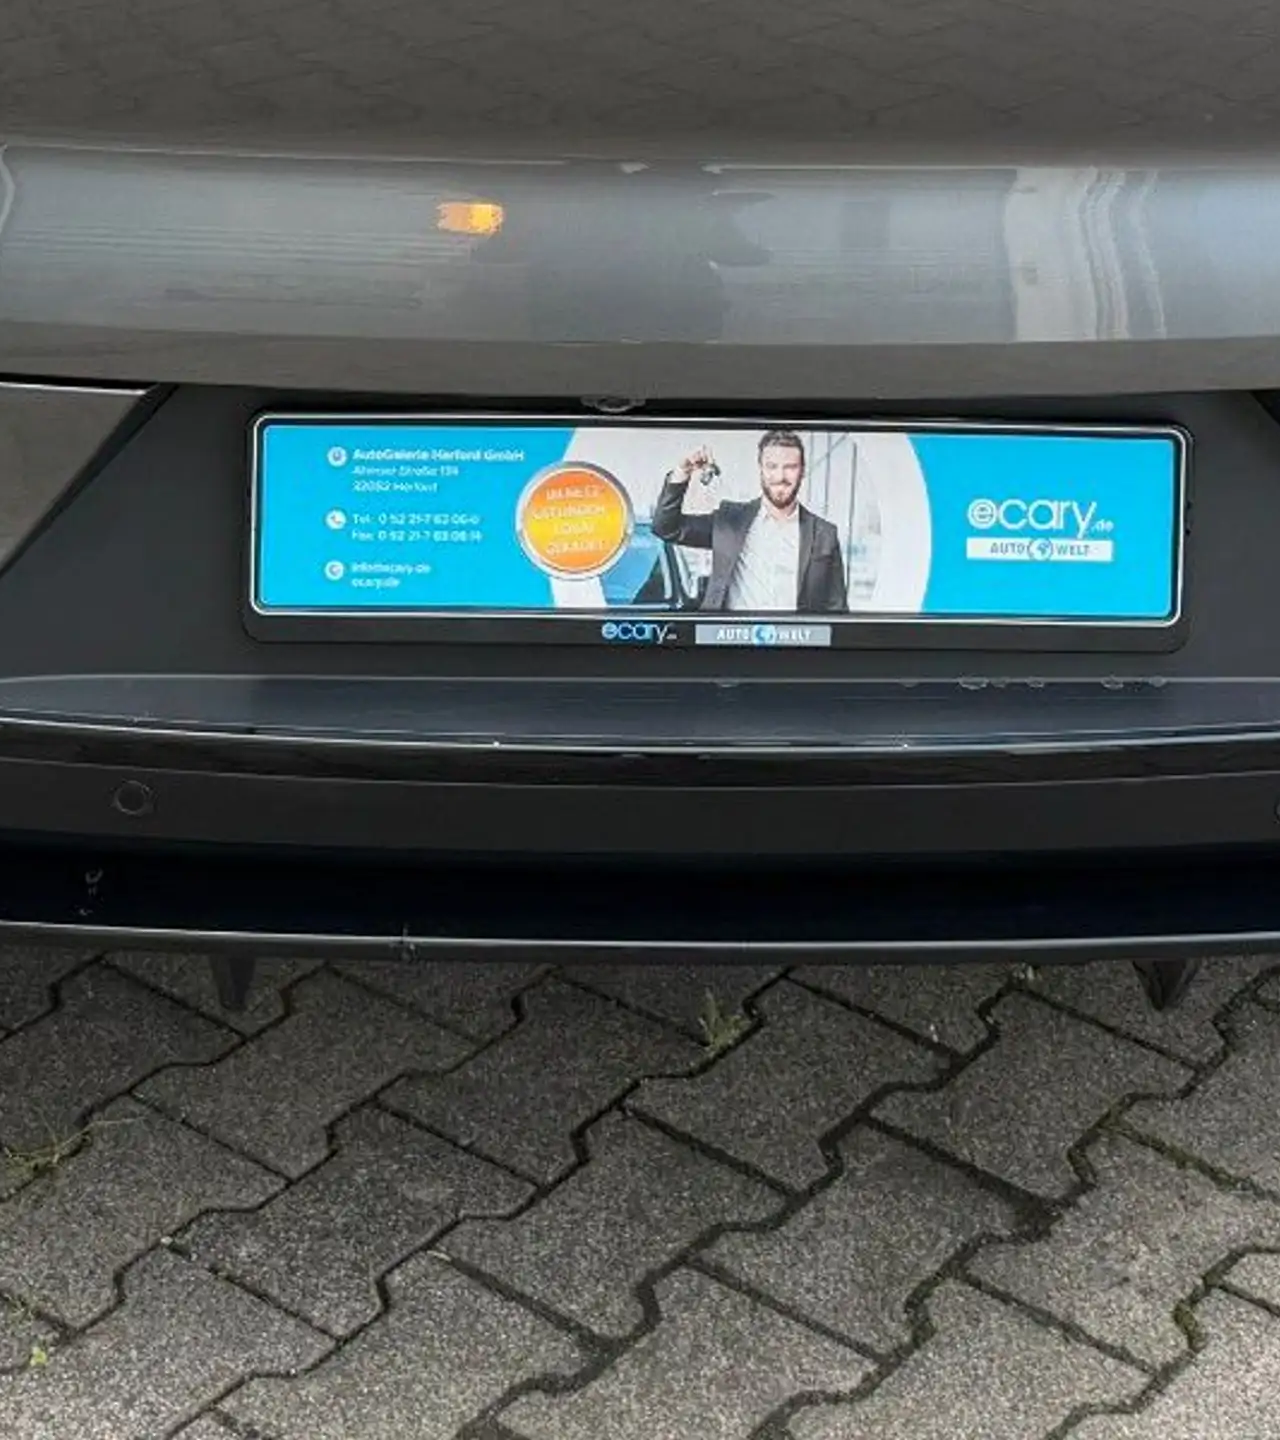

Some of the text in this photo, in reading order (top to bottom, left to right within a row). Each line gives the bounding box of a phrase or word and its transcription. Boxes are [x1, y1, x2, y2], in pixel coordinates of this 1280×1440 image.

[353, 448, 525, 462] AutoGalerie Herford GmbH
[989, 541, 1091, 557] AUTO WELT
[716, 627, 750, 641] AUTO
